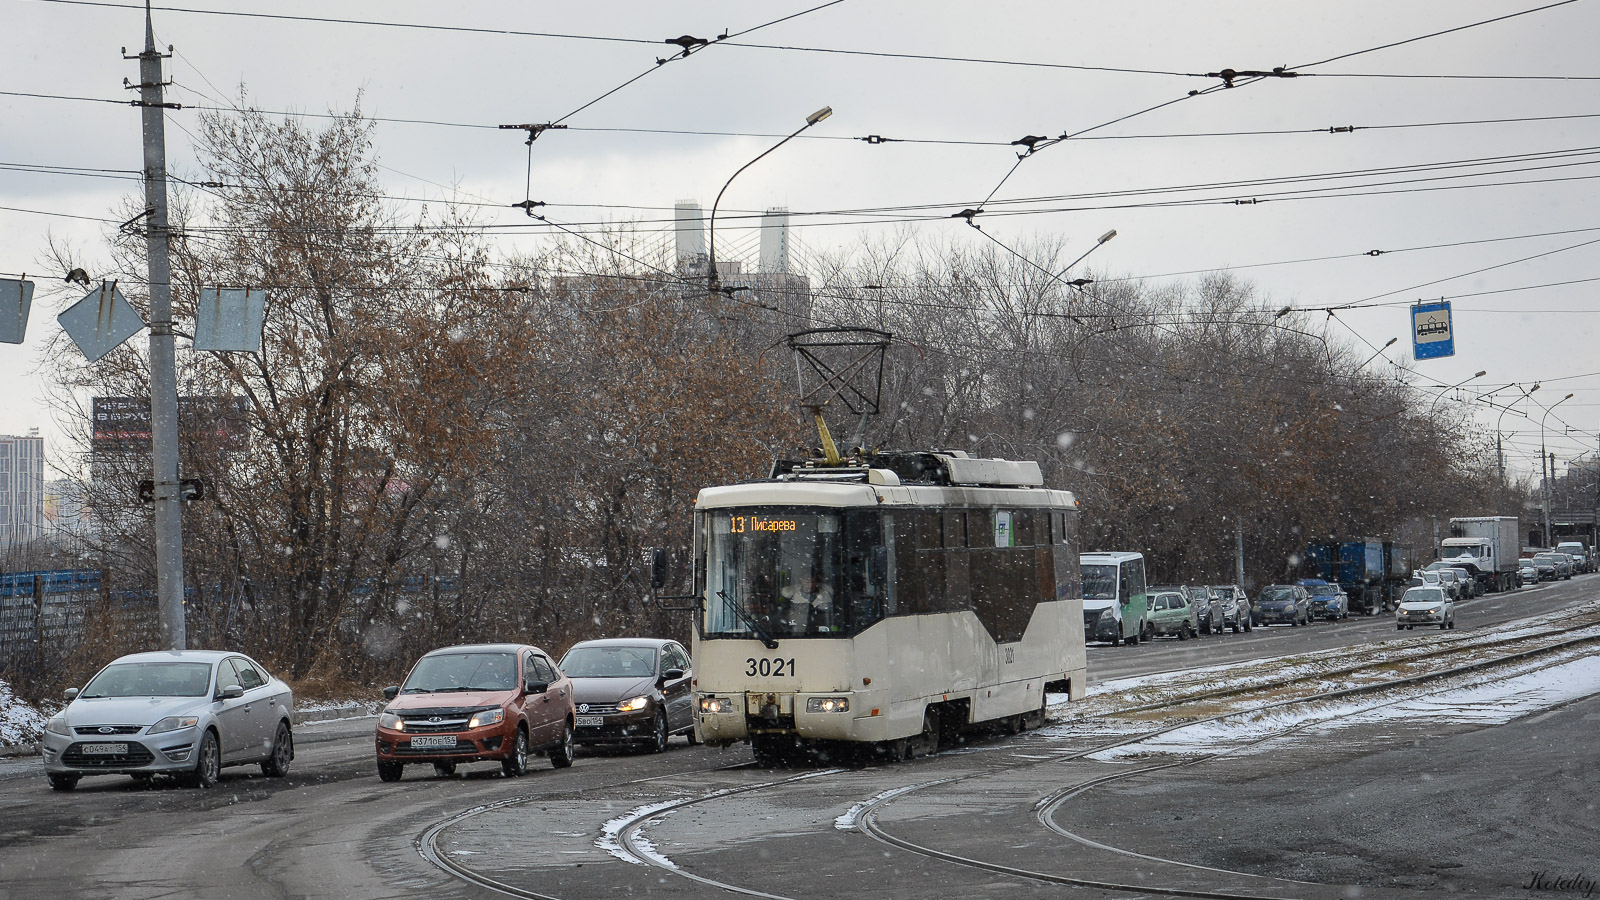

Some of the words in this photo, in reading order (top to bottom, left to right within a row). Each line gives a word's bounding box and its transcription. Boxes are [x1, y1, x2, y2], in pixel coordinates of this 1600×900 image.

[731, 516, 745, 533] 13
[751, 516, 796, 533] Писарева
[745, 657, 795, 677] 3021
